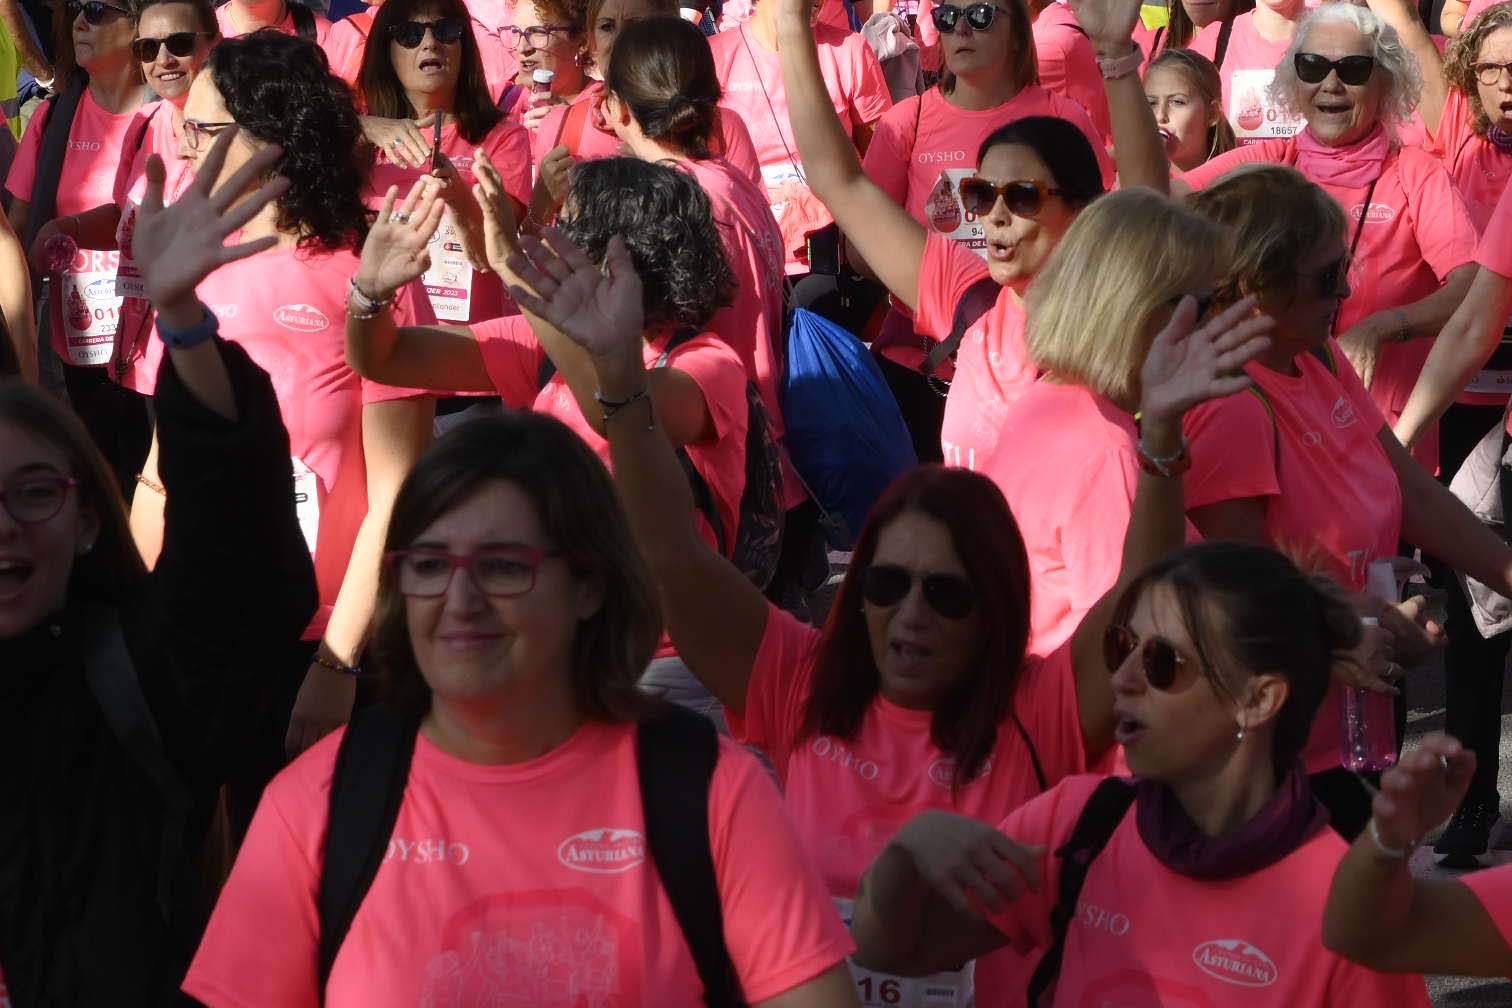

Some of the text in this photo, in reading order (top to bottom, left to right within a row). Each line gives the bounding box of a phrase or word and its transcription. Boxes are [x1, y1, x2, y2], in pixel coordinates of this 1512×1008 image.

[1271, 126, 1298, 136] 18657
[918, 150, 966, 164] OYSHO
[280, 310, 325, 329] ASTURIANA
[566, 845, 645, 863] ASTURIANA
[1202, 948, 1270, 983] ASTURIANA
[857, 976, 902, 1005] 16
